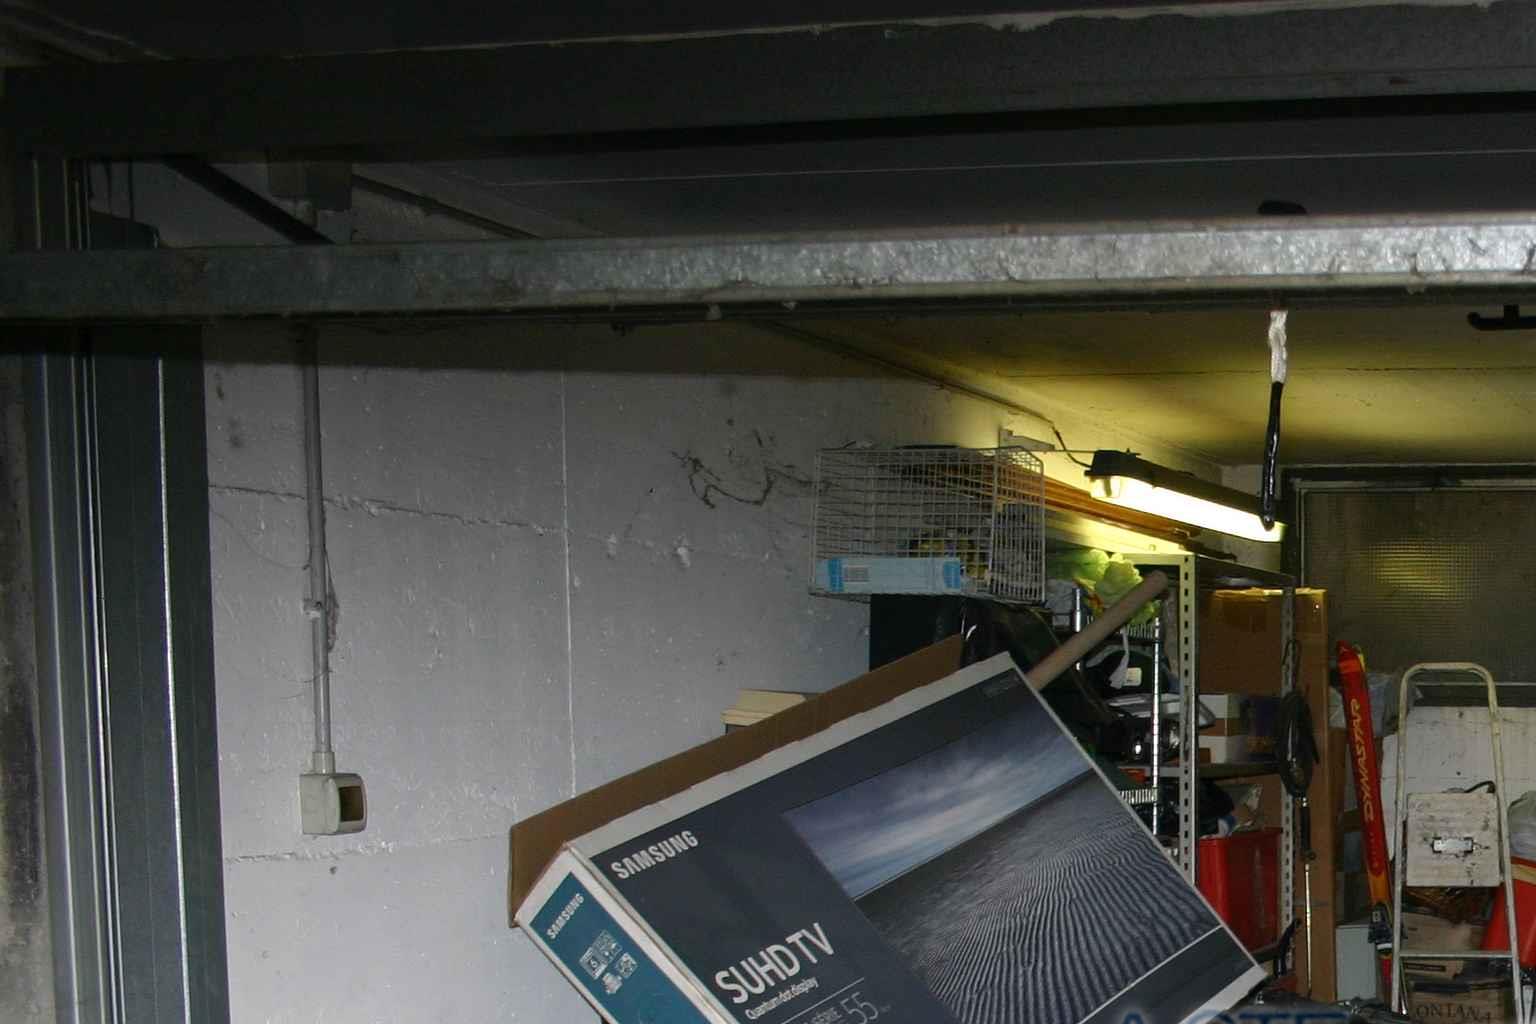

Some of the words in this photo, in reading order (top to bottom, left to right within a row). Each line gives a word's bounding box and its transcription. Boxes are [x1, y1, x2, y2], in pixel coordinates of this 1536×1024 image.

[1350, 698, 1375, 822] DYNASTAR
[611, 830, 699, 880] SAMSUNG
[546, 892, 585, 940] SAMSUNG
[715, 944, 801, 1004] SUHD
[785, 922, 834, 964] TV
